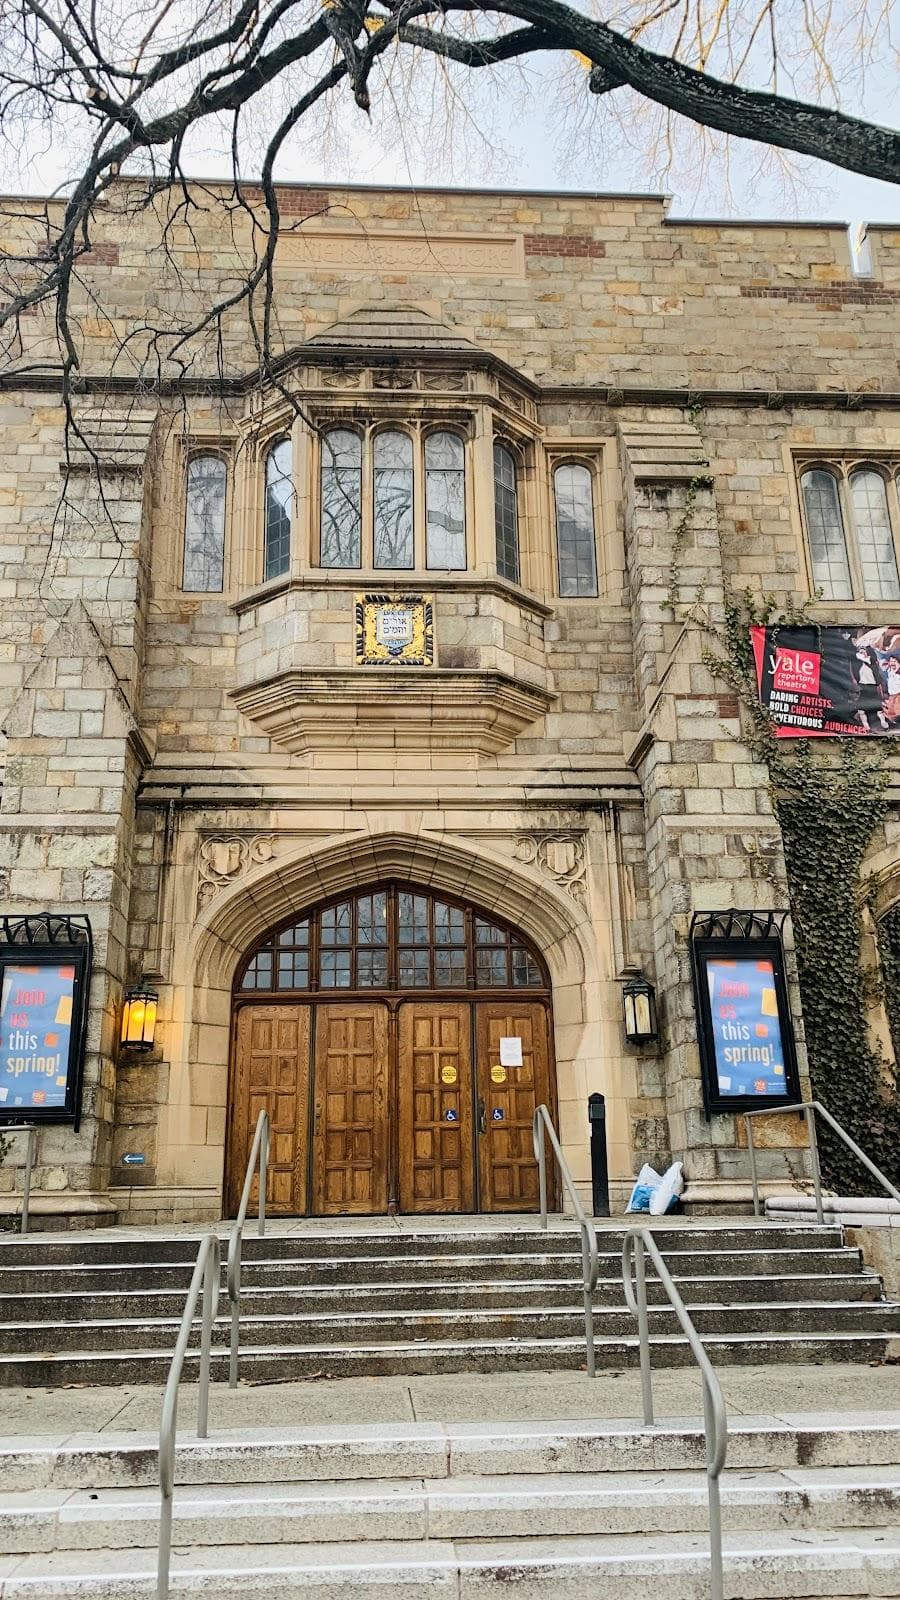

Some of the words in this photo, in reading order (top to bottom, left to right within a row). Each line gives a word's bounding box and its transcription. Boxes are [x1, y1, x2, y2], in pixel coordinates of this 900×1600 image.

[768, 652, 814, 675] yale
[777, 678, 807, 690] theatre
[778, 672, 815, 685] repertory
[769, 700, 789, 713] BOLD
[790, 704, 826, 718] CHOICES.
[770, 690, 799, 703] DARING
[800, 695, 835, 709] ARTISTS.
[9, 1030, 38, 1050] this
[721, 1021, 750, 1041] this
[723, 1043, 774, 1067] spring!
[6, 1054, 61, 1077] spring!
